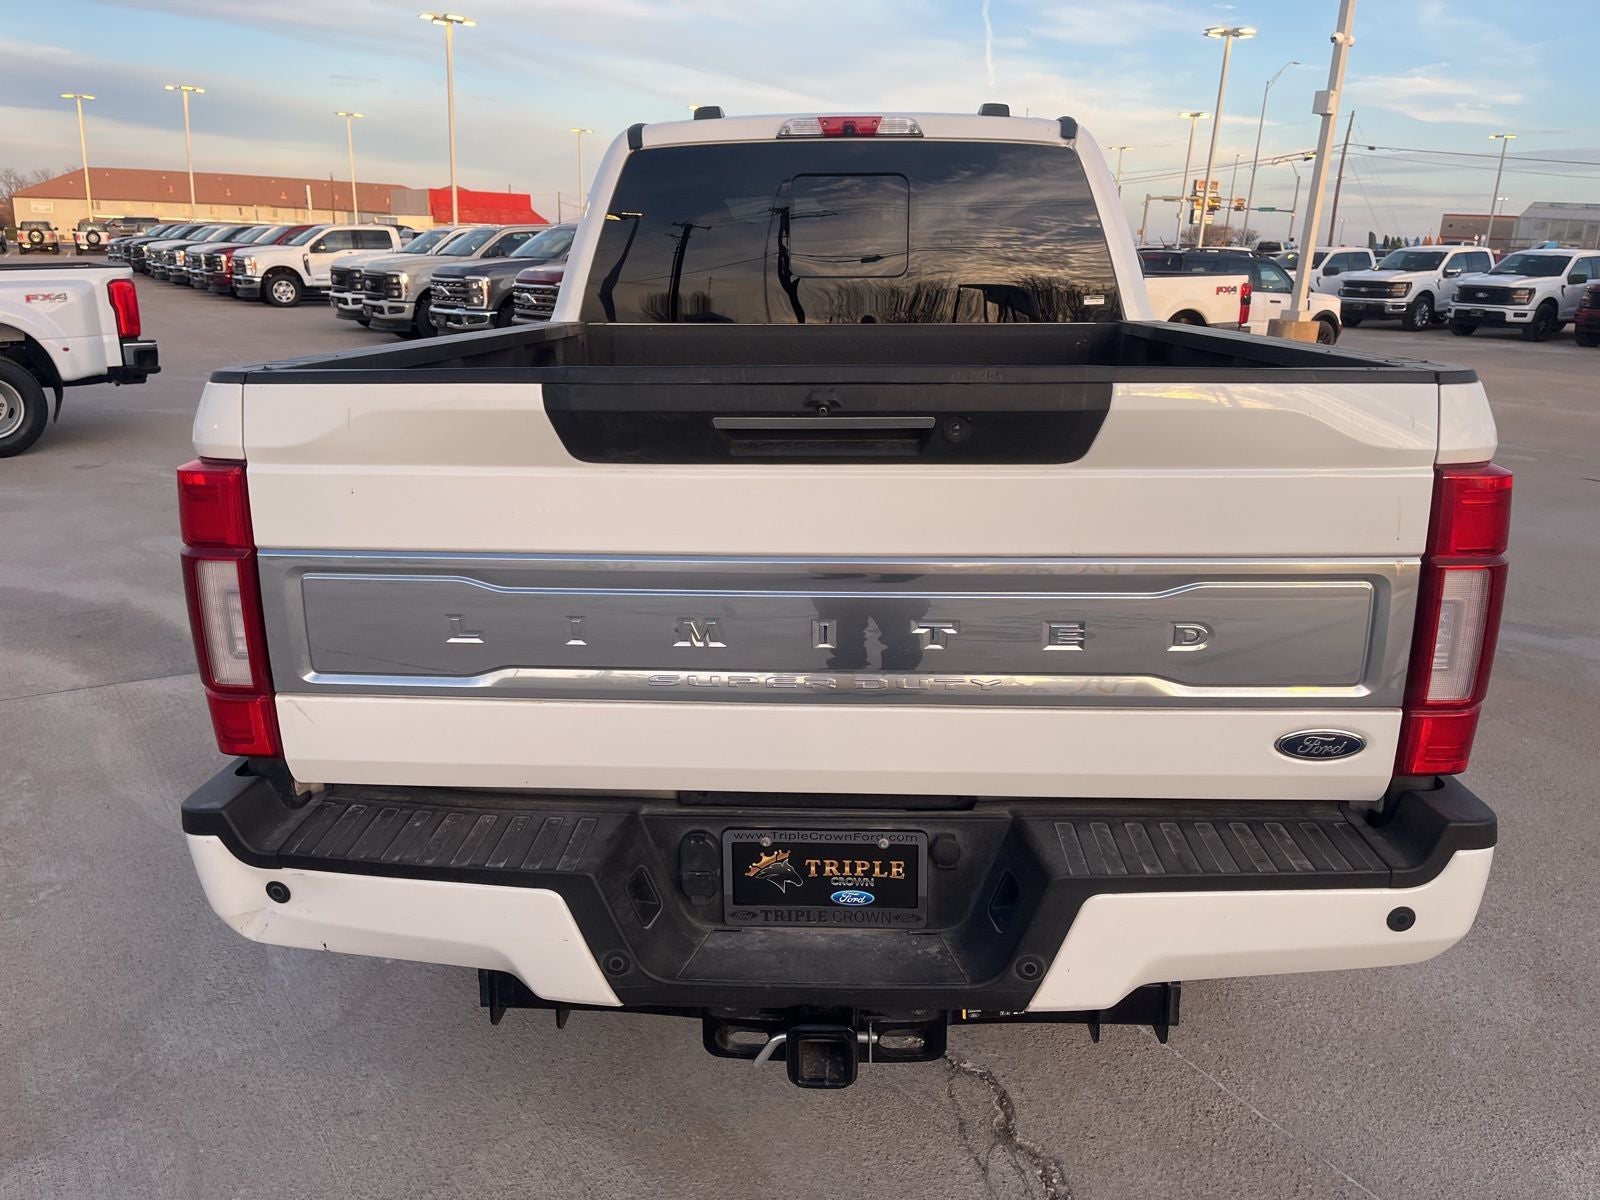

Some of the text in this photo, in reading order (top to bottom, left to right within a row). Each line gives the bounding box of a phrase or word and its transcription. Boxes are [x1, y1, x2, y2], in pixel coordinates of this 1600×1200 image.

[25, 293, 68, 303] FX4
[444, 613, 1210, 651] LIMITED
[649, 674, 1002, 691] SUPER DUTY
[733, 832, 918, 842] wwwTripleCrownFordcom
[804, 859, 905, 880] TRIPLE
[830, 876, 875, 887] CROWN
[760, 909, 828, 923] TRIPLE
[832, 911, 893, 924] CROWN
